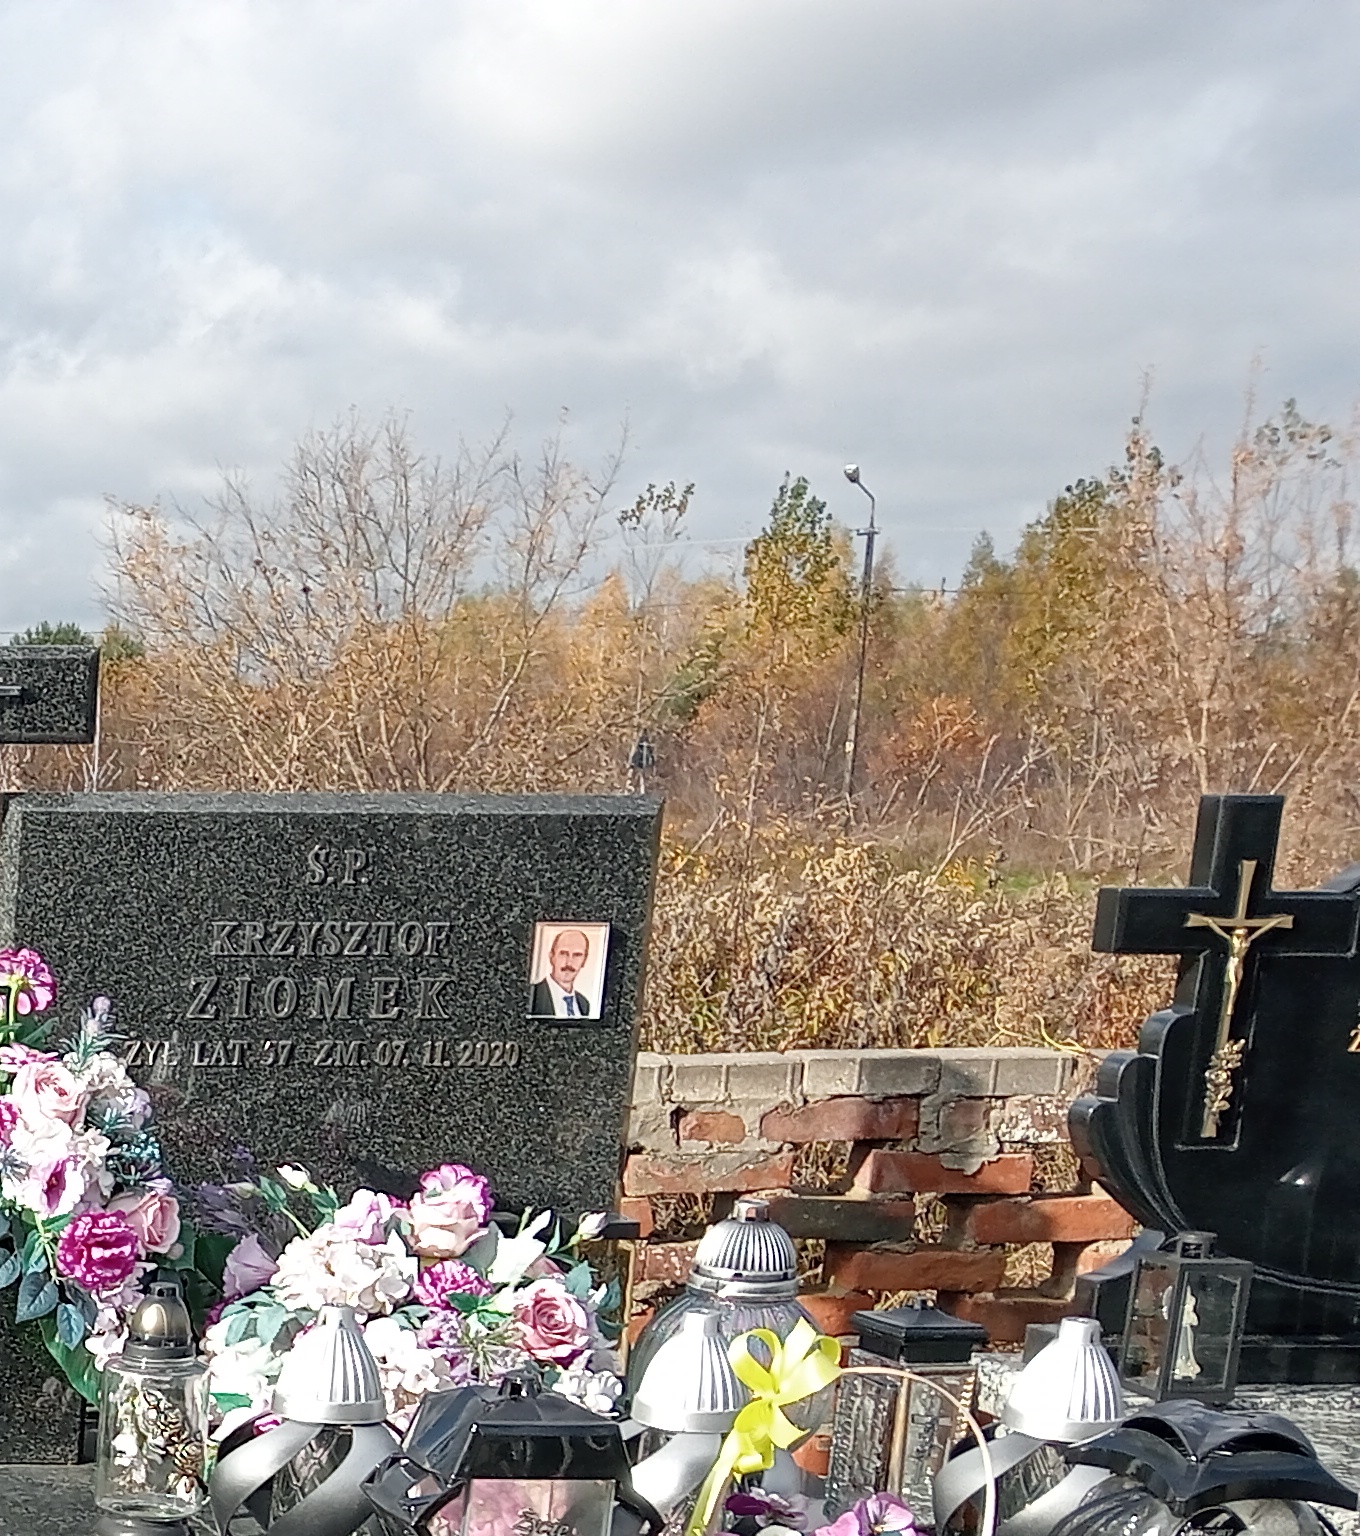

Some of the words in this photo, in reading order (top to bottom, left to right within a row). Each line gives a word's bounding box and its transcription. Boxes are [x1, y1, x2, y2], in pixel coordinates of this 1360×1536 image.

[210, 921, 450, 956] KRZYSZTOF
[186, 976, 457, 1019] ZIOMEK
[192, 1040, 248, 1066] LAT
